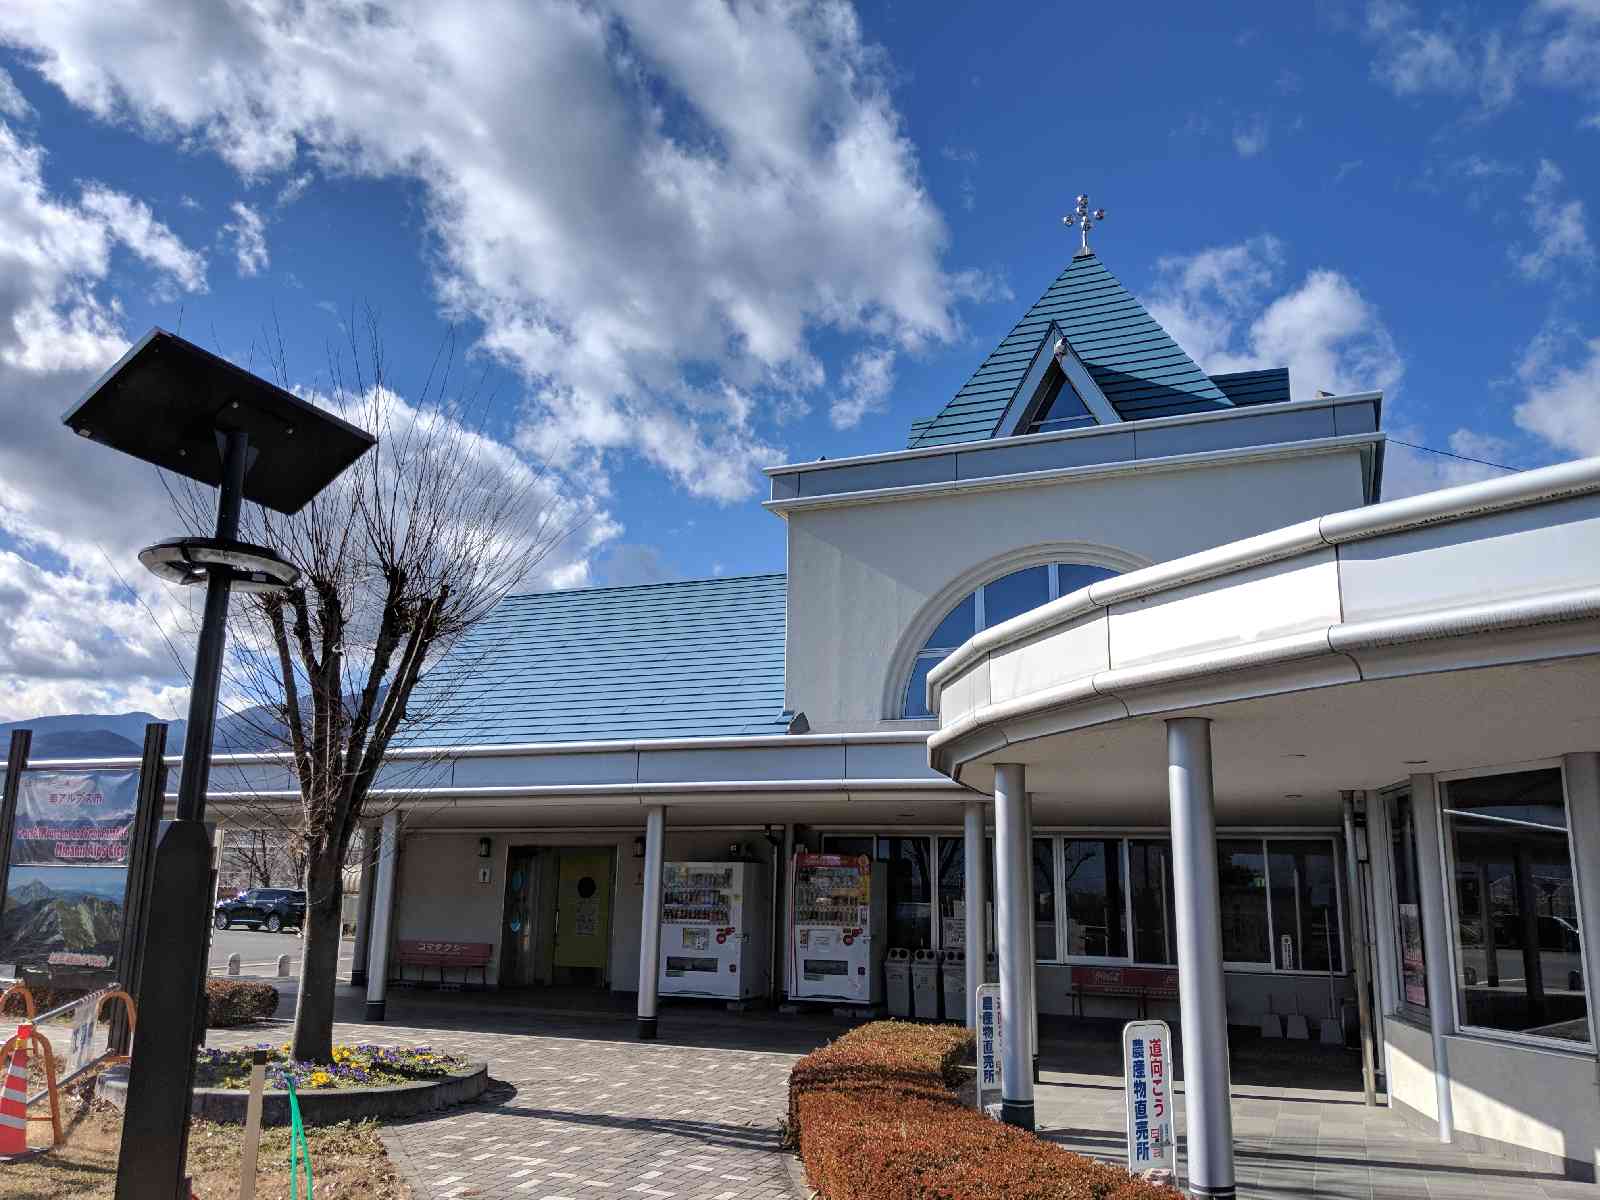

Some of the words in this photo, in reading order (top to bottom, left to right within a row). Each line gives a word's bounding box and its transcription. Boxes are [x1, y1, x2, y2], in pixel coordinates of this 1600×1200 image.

[982, 996, 995, 1084] 農産物直売所
[1149, 1038, 1165, 1118] 道向こう
[1132, 1038, 1150, 1161] 農産物直売所
